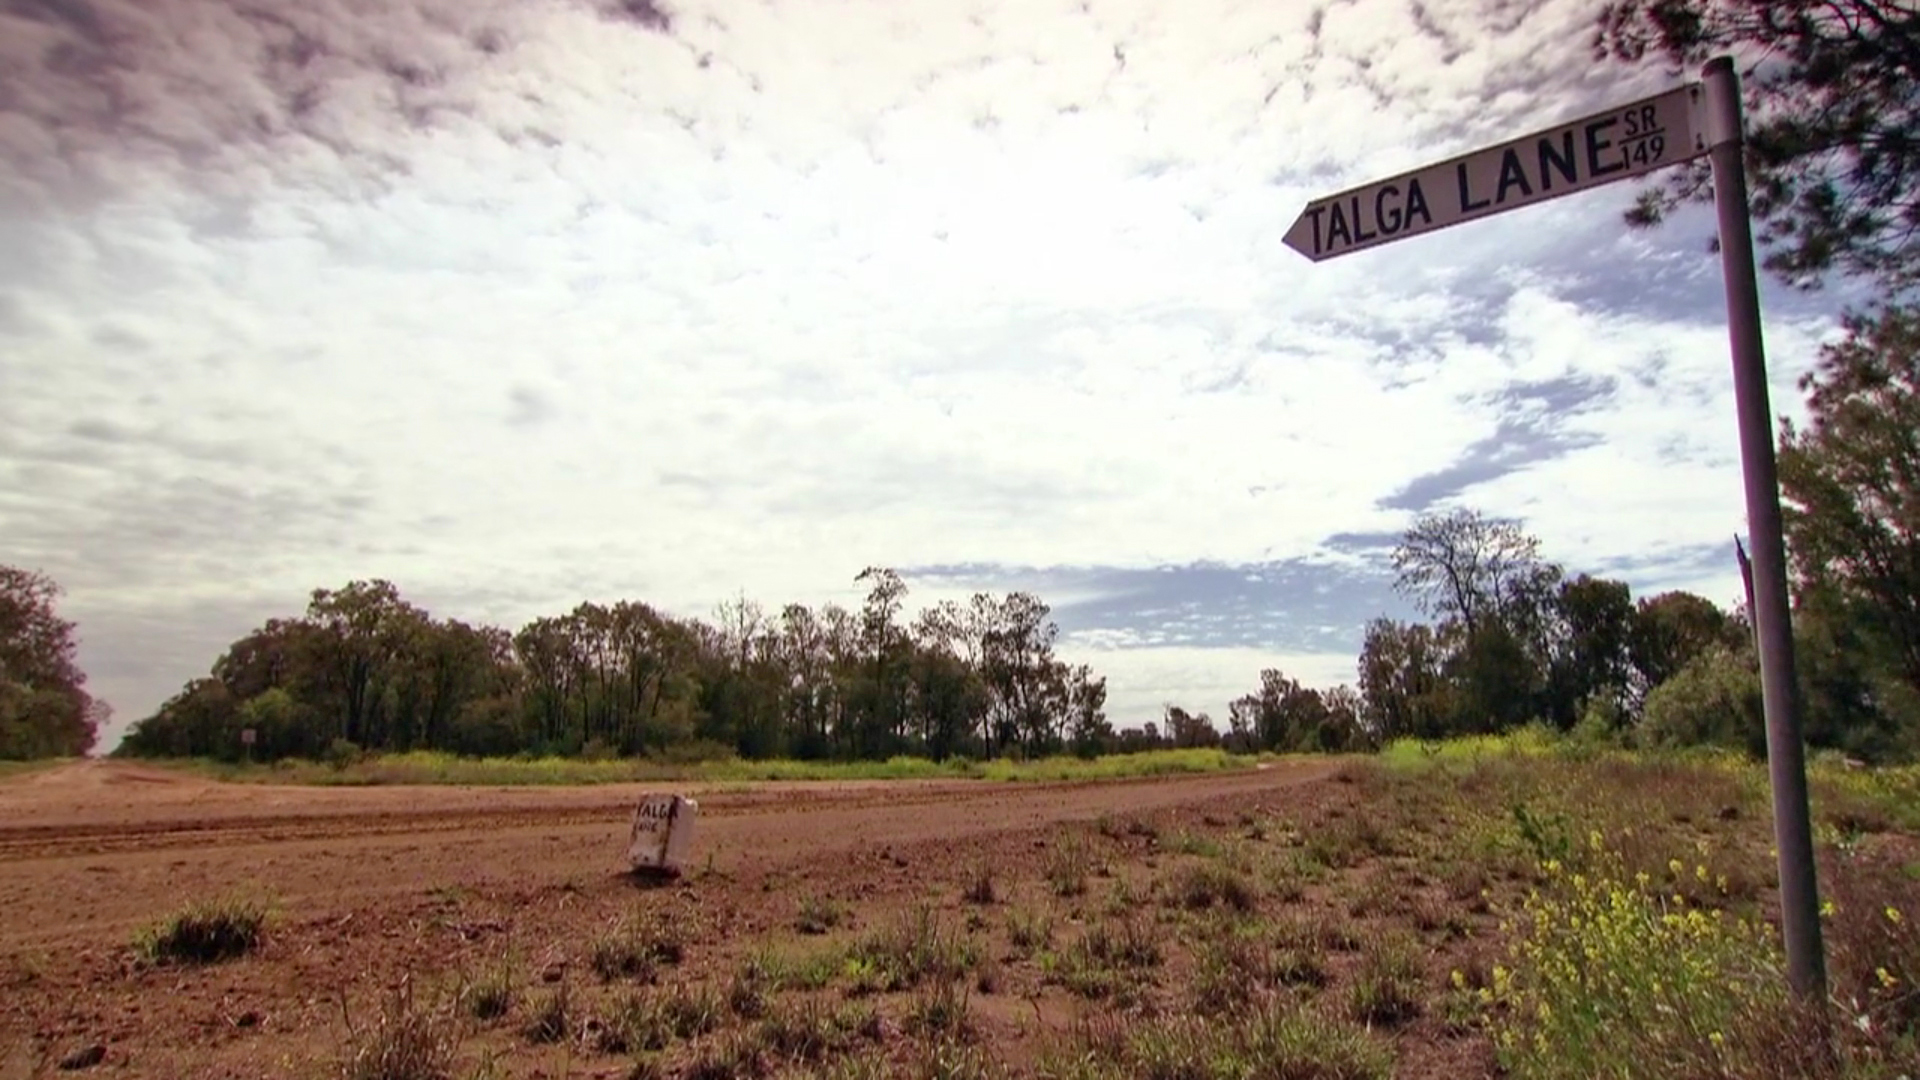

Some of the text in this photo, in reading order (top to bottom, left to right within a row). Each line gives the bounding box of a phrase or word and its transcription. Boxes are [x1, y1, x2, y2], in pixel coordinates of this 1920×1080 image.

[1624, 104, 1656, 136] SR
[1621, 135, 1664, 170] 149
[1306, 117, 1625, 255] TALGA LANE
